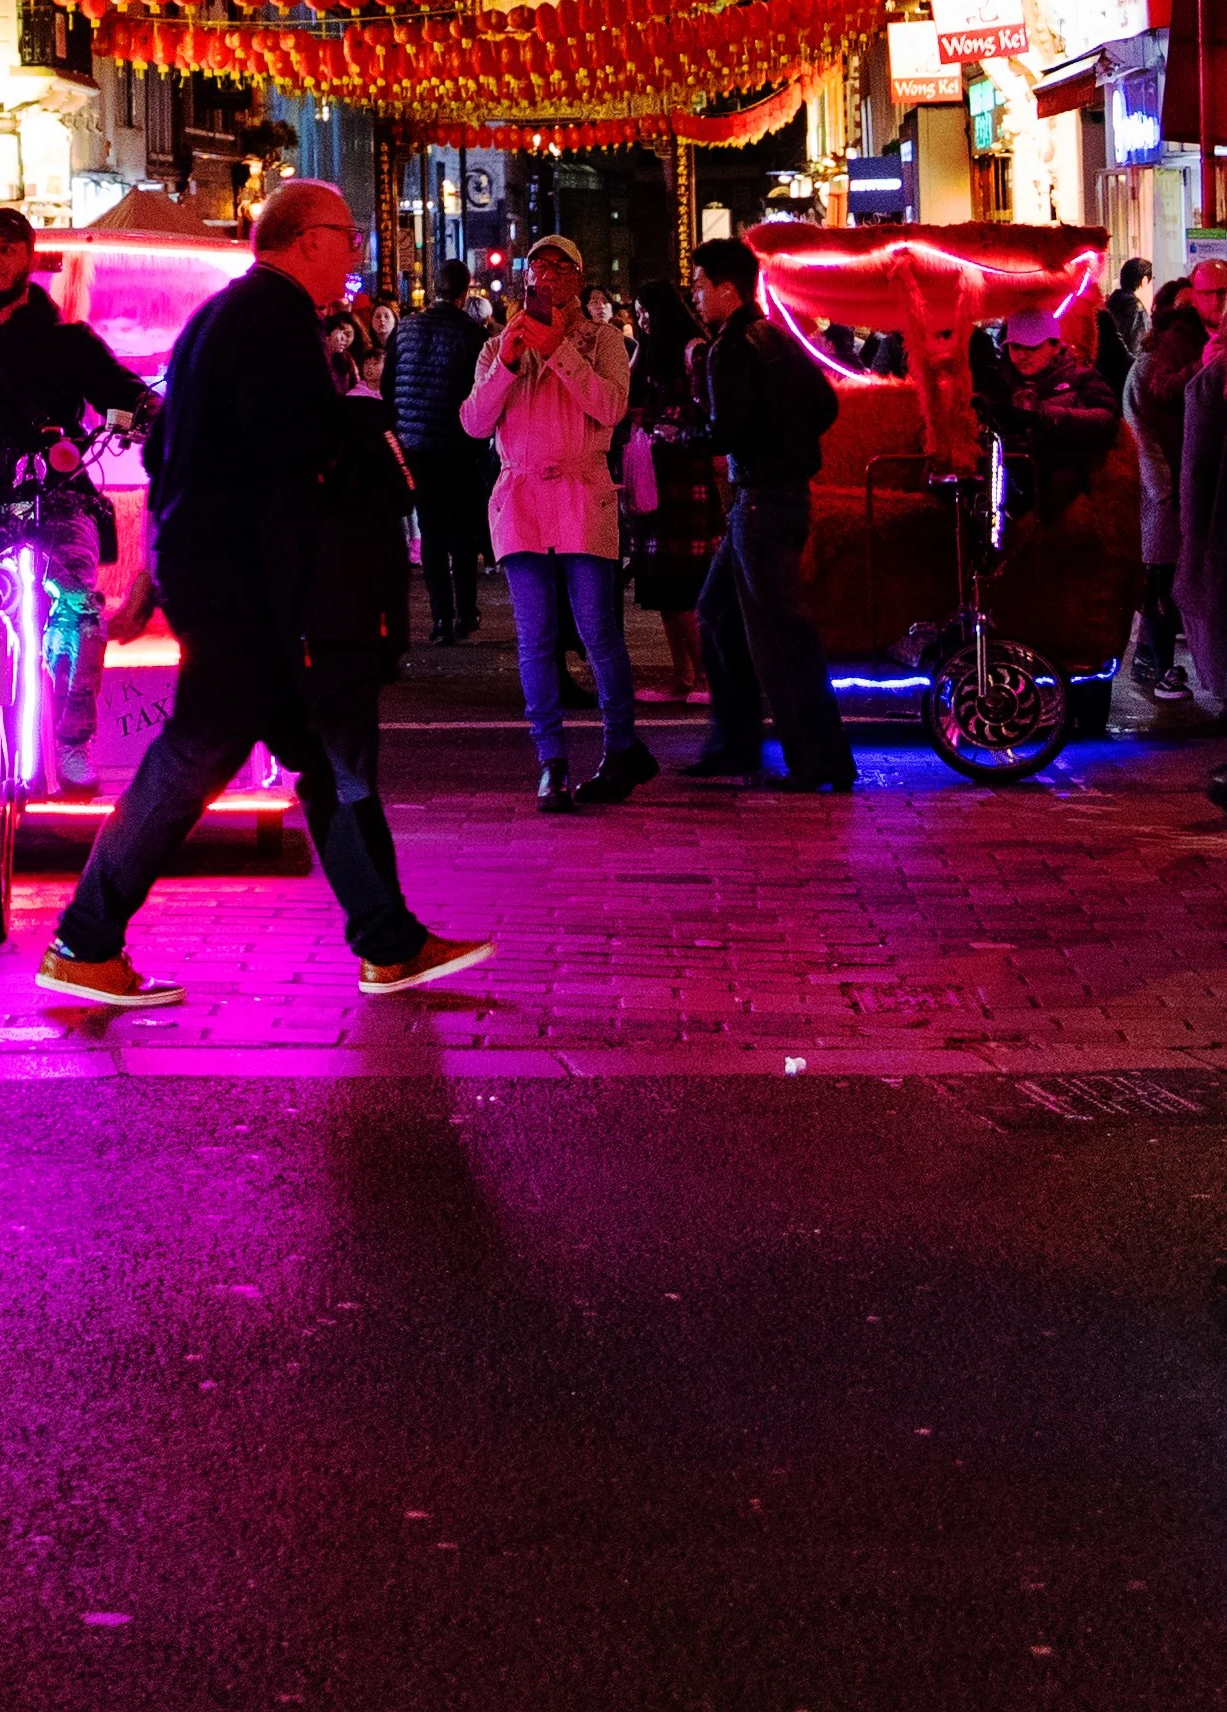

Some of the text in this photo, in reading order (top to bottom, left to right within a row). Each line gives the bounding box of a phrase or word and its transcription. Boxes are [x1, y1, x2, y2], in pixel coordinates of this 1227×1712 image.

[941, 28, 1026, 57] Wong Kei
[894, 79, 960, 99] Wong Kei
[116, 695, 172, 738] TAX
